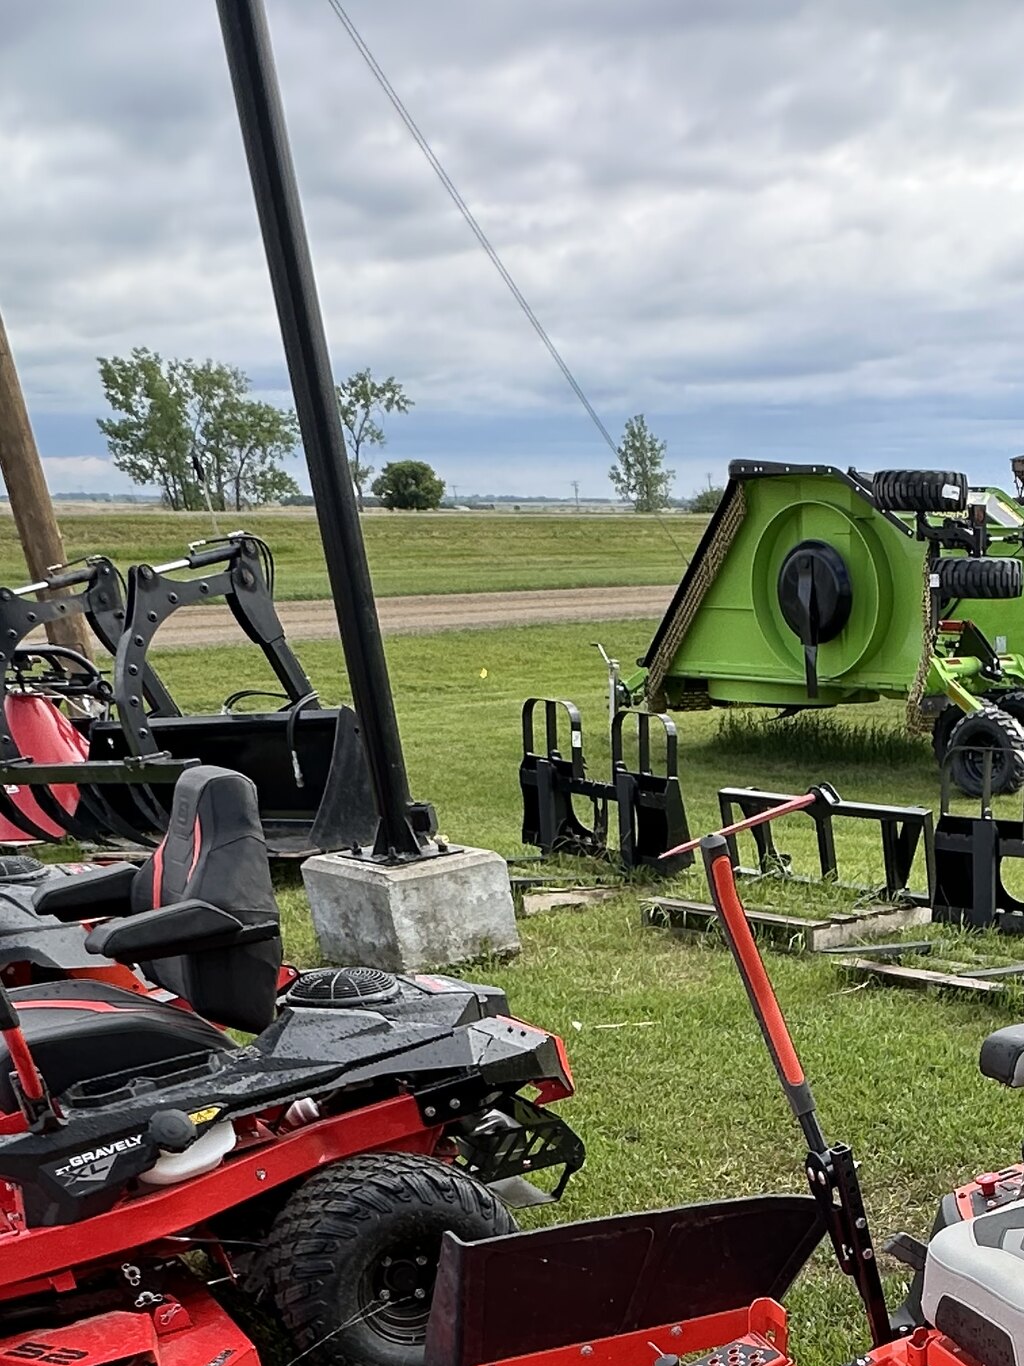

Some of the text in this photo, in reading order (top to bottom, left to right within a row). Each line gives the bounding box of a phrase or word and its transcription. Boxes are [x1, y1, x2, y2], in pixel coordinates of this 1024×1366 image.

[68, 1134, 142, 1167] GRAVELY
[64, 1163, 110, 1184] XL
[4, 1341, 90, 1366] 52
